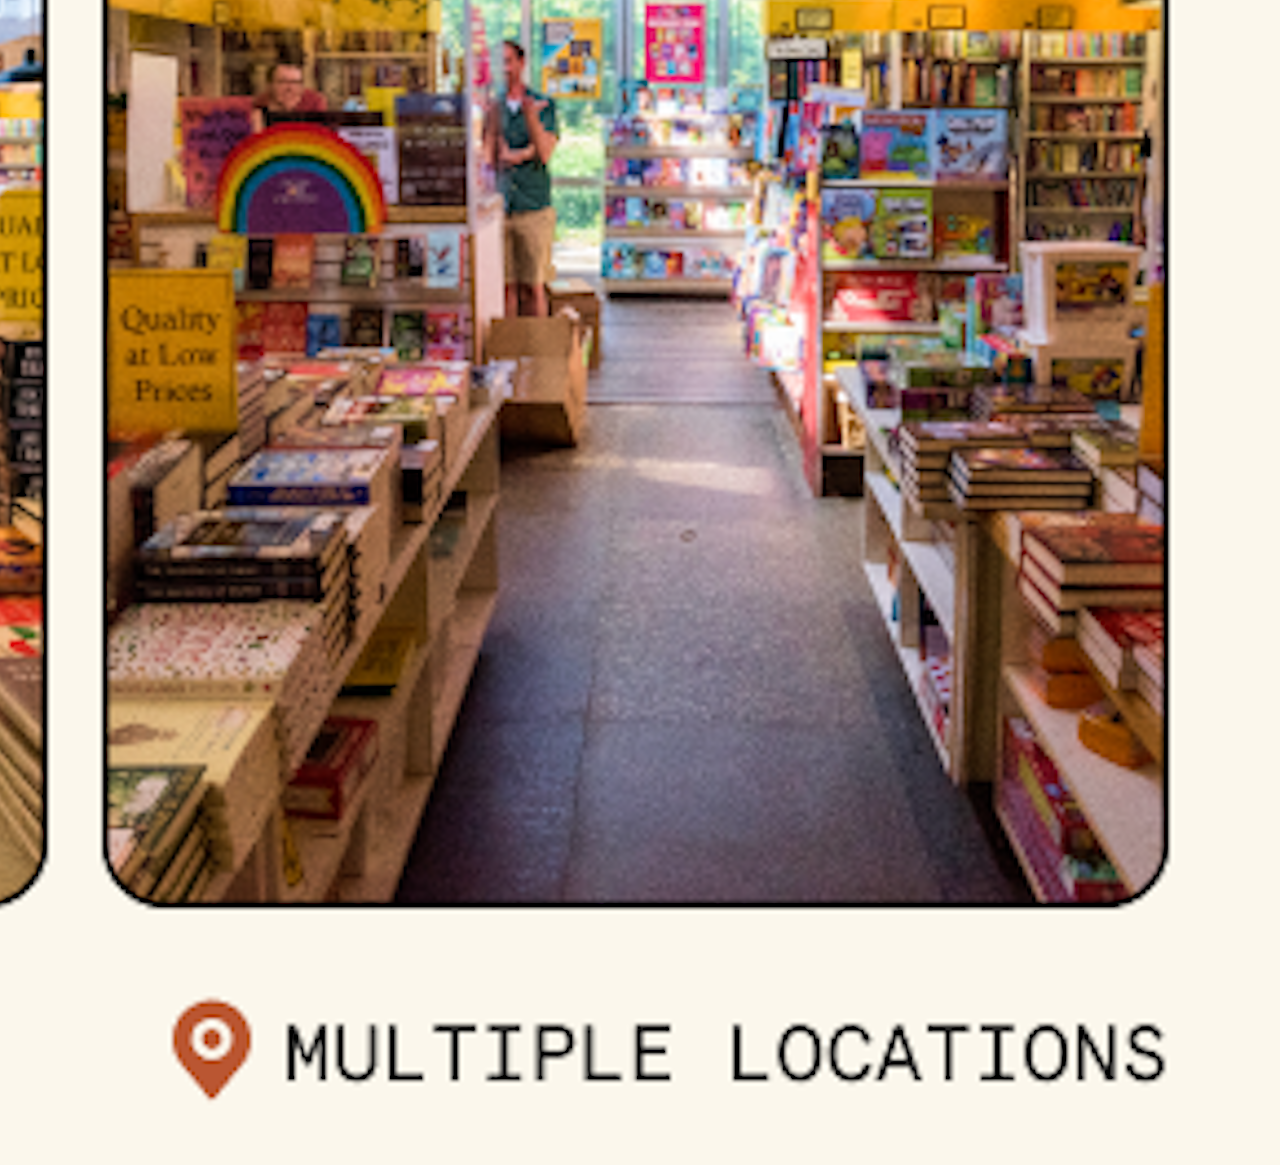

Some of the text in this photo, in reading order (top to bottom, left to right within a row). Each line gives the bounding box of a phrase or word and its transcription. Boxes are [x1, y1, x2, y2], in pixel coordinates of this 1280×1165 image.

[119, 304, 222, 336] Quality
[125, 342, 217, 366] at Low
[135, 379, 213, 402] Prices
